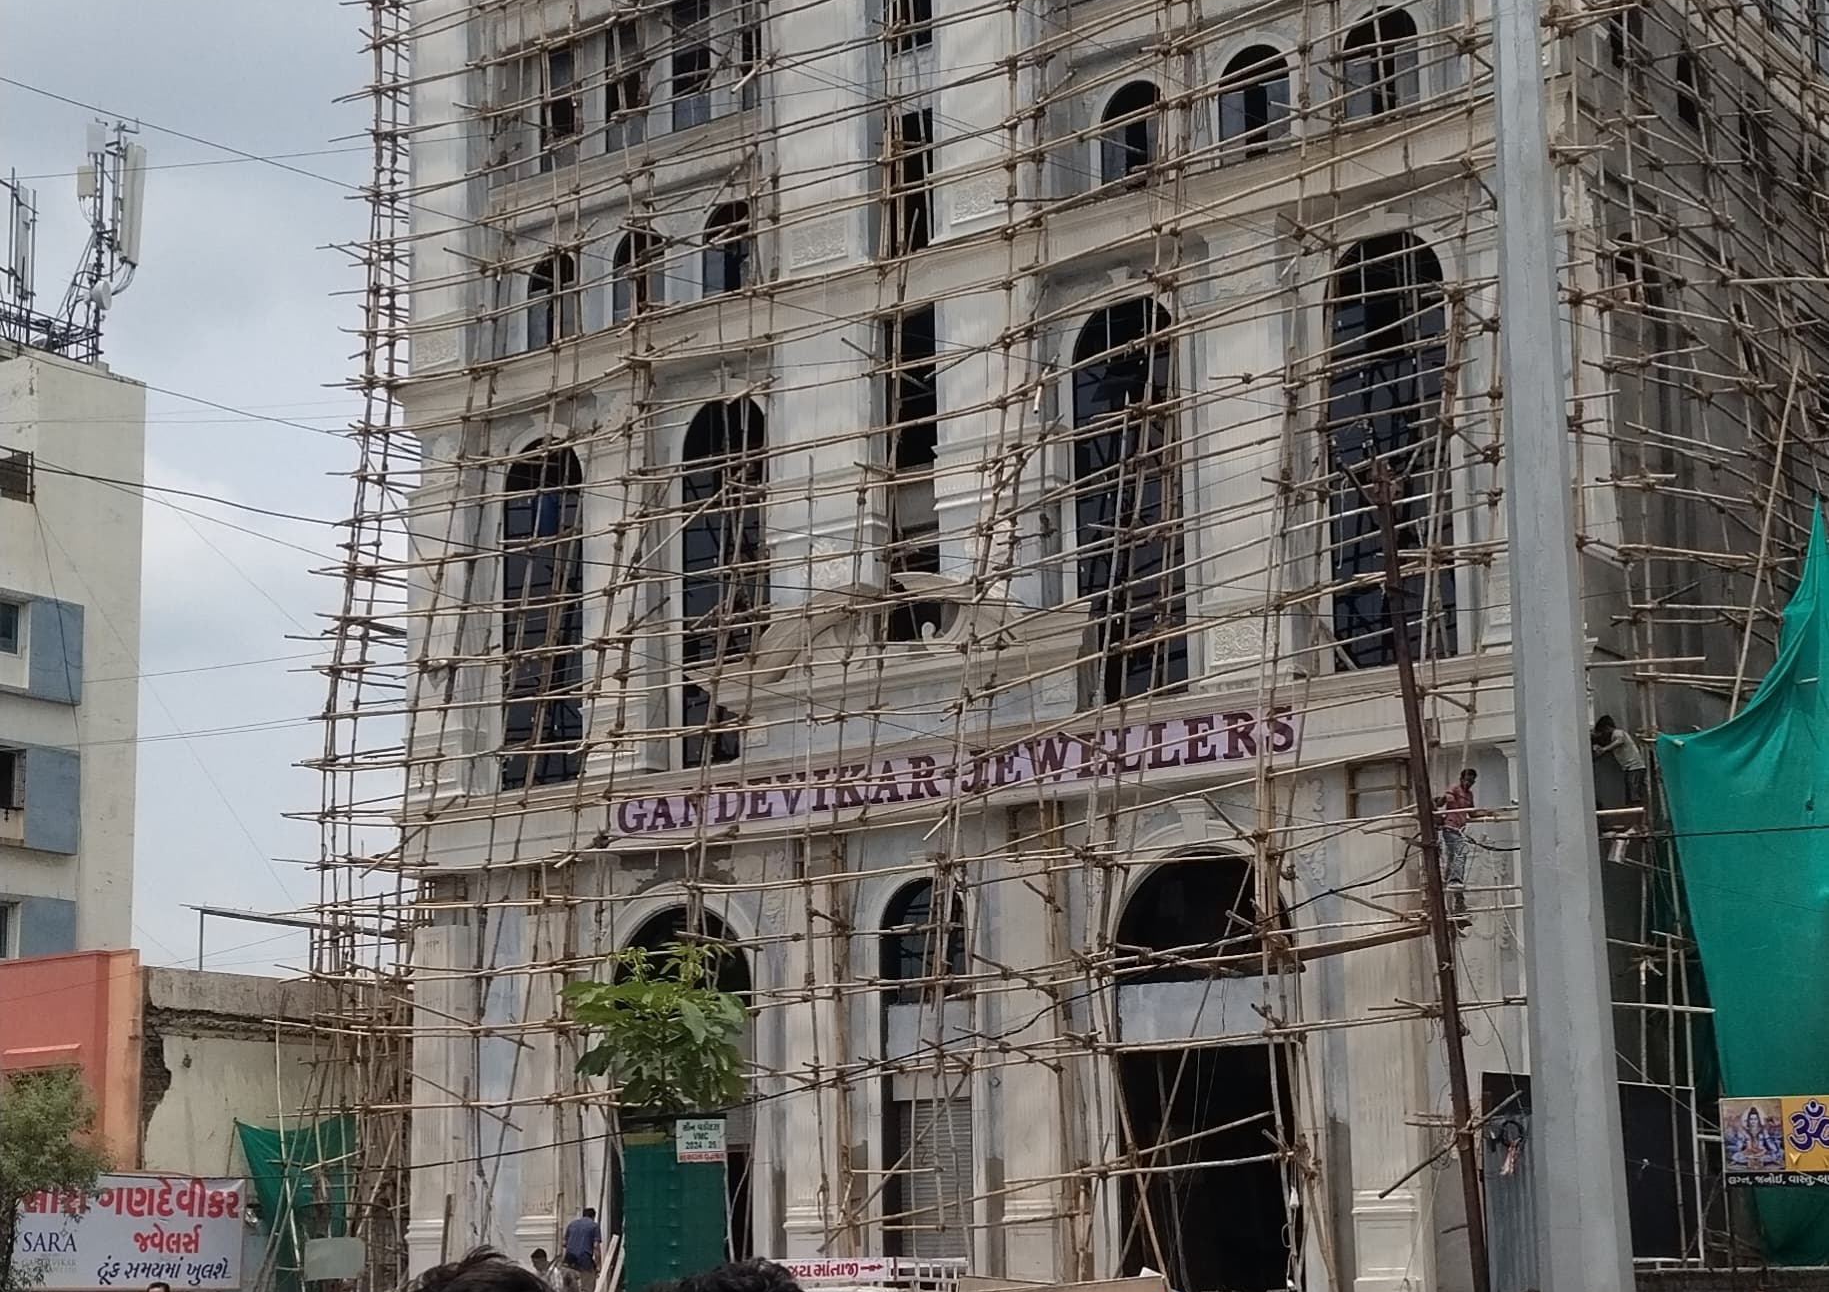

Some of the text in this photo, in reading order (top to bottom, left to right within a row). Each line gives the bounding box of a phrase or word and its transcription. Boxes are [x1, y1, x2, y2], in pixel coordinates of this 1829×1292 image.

[617, 705, 1296, 834] GANDEVIKAR JEWELLERS
[98, 1175, 240, 1219] ગણદેવીકર
[22, 1231, 77, 1253] SARA
[124, 1256, 184, 1280] સમયમાં
